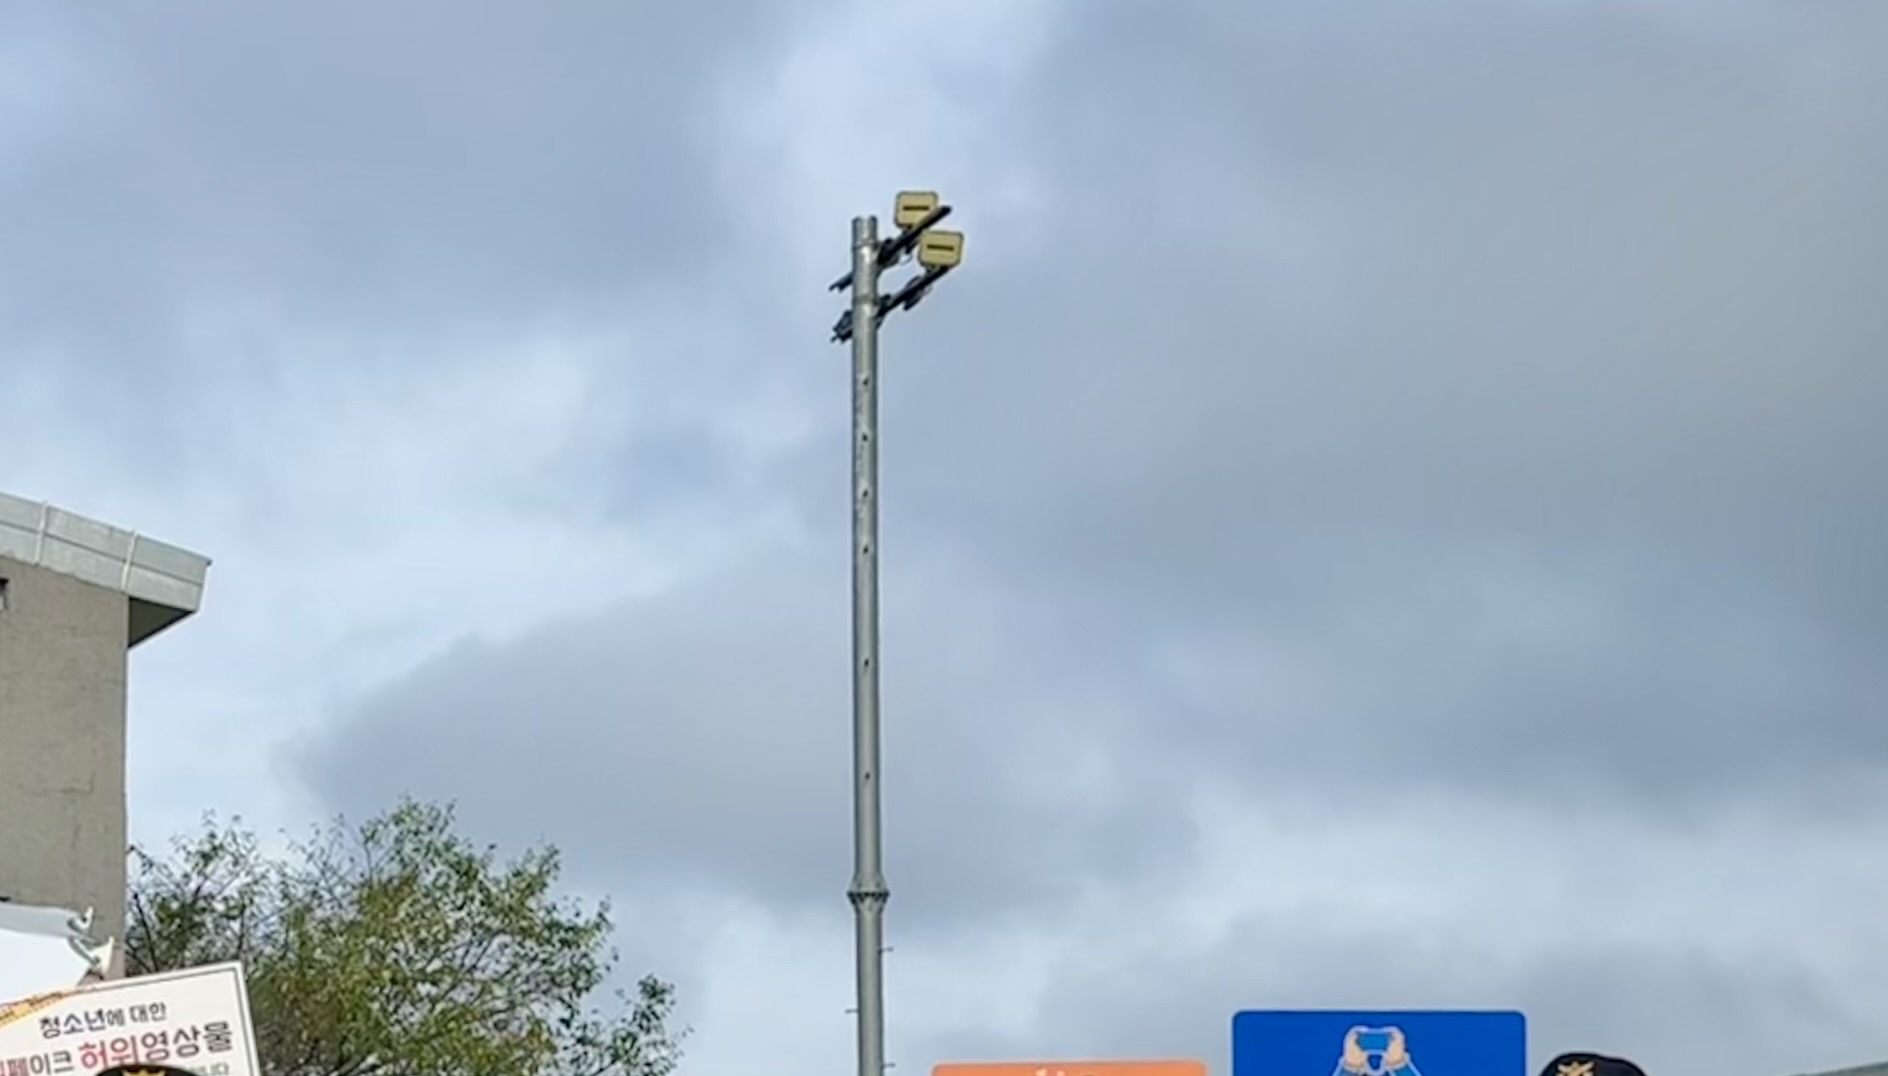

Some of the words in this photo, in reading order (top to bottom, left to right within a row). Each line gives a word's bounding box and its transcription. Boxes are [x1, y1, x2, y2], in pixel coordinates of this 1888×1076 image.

[38, 1008, 126, 1040] 청소년에
[130, 1002, 167, 1023] 대한
[77, 1020, 235, 1071] 허위영상물
